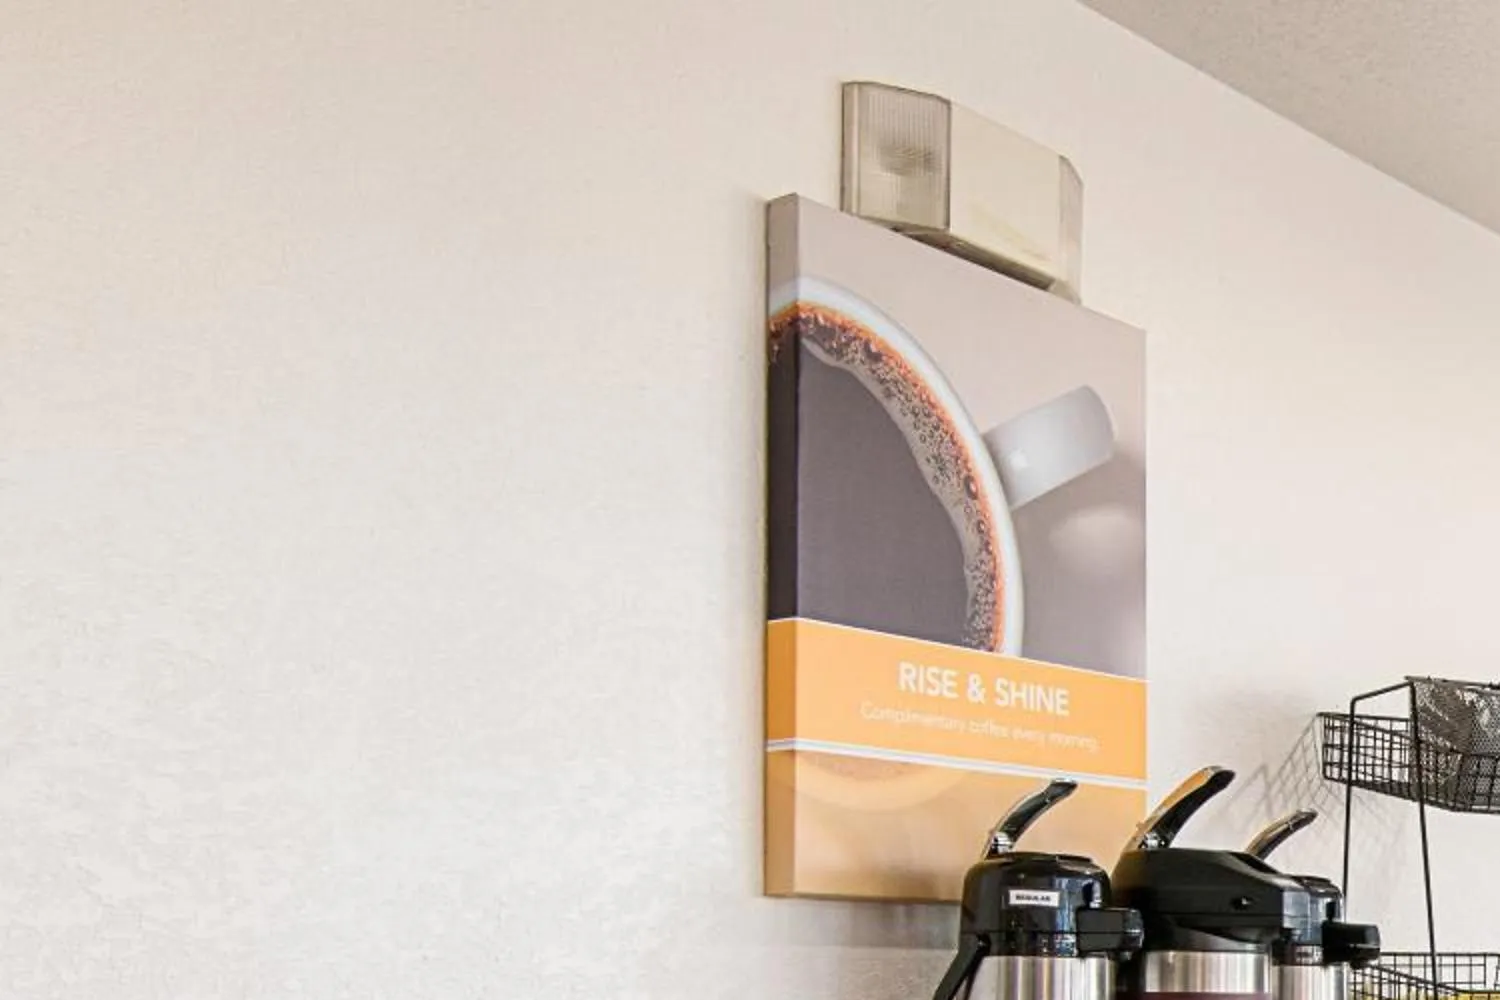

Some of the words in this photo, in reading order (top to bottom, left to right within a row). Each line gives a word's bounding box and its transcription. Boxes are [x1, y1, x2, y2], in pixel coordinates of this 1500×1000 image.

[898, 662, 959, 698] RISE
[967, 672, 986, 704] &
[994, 677, 1070, 716] SHINE
[859, 701, 966, 733] Complimentary
[969, 718, 1009, 738] coffee
